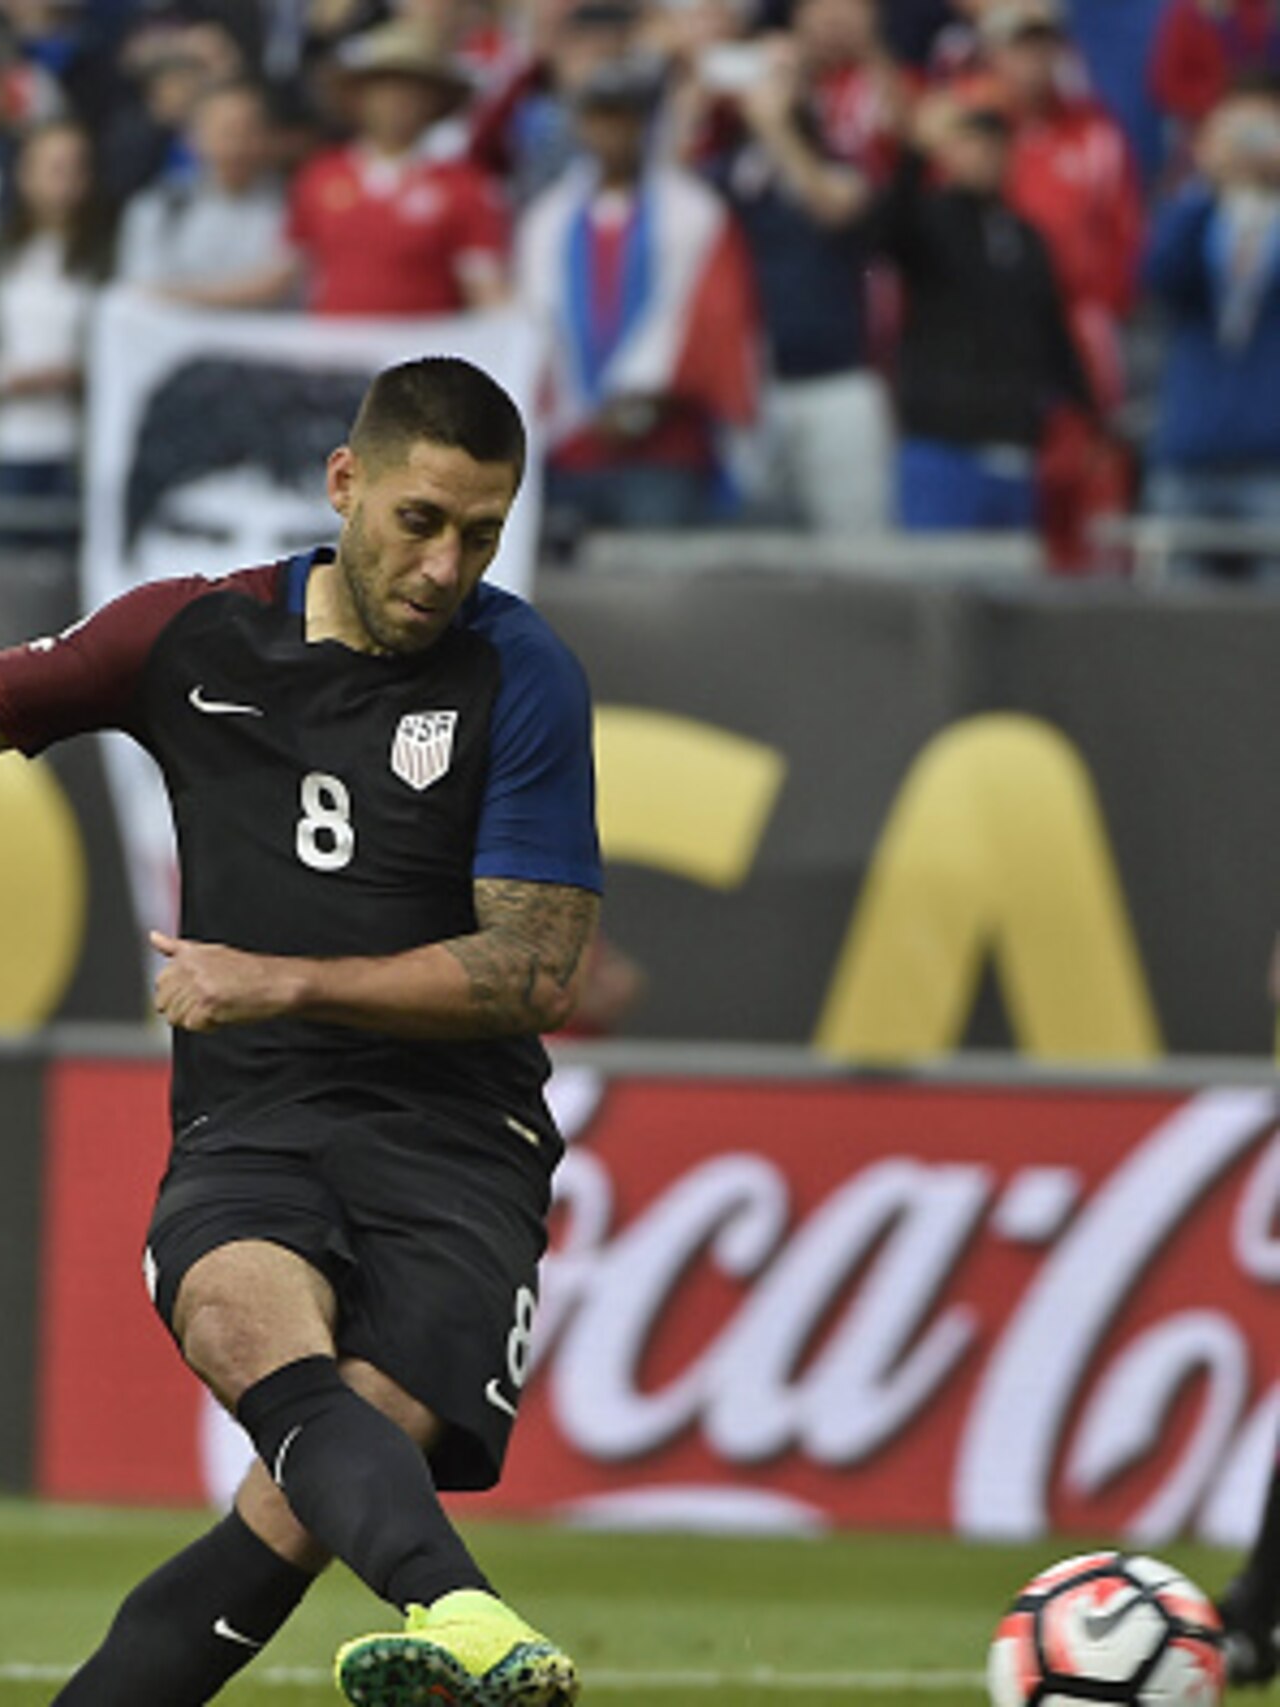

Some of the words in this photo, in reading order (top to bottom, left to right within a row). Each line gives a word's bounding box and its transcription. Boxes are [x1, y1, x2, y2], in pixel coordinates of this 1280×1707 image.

[402, 714, 452, 743] USA
[296, 771, 355, 872] 8
[507, 1285, 537, 1389] 8
